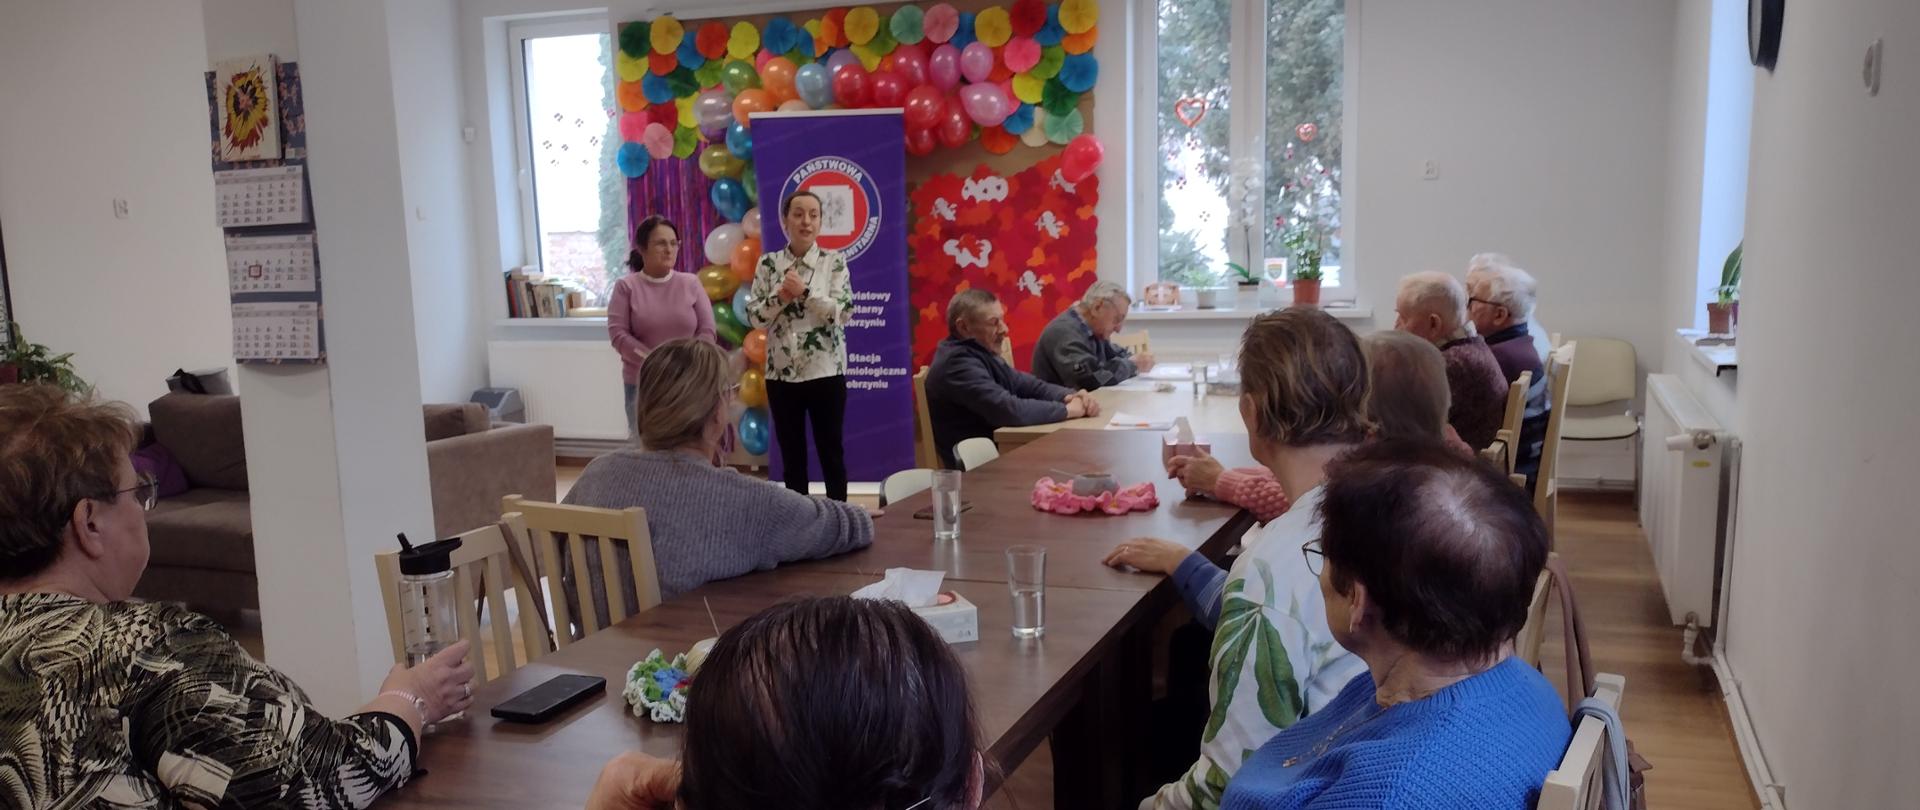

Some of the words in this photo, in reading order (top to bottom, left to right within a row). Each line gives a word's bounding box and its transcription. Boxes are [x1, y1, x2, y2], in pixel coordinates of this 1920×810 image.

[852, 291, 891, 302] wiatowy
[854, 304, 884, 316] itarny
[844, 318, 886, 329] obrzyniu
[848, 353, 881, 364] Stacja
[846, 366, 907, 377] miologiczna
[846, 379, 888, 390] obrzyniu
